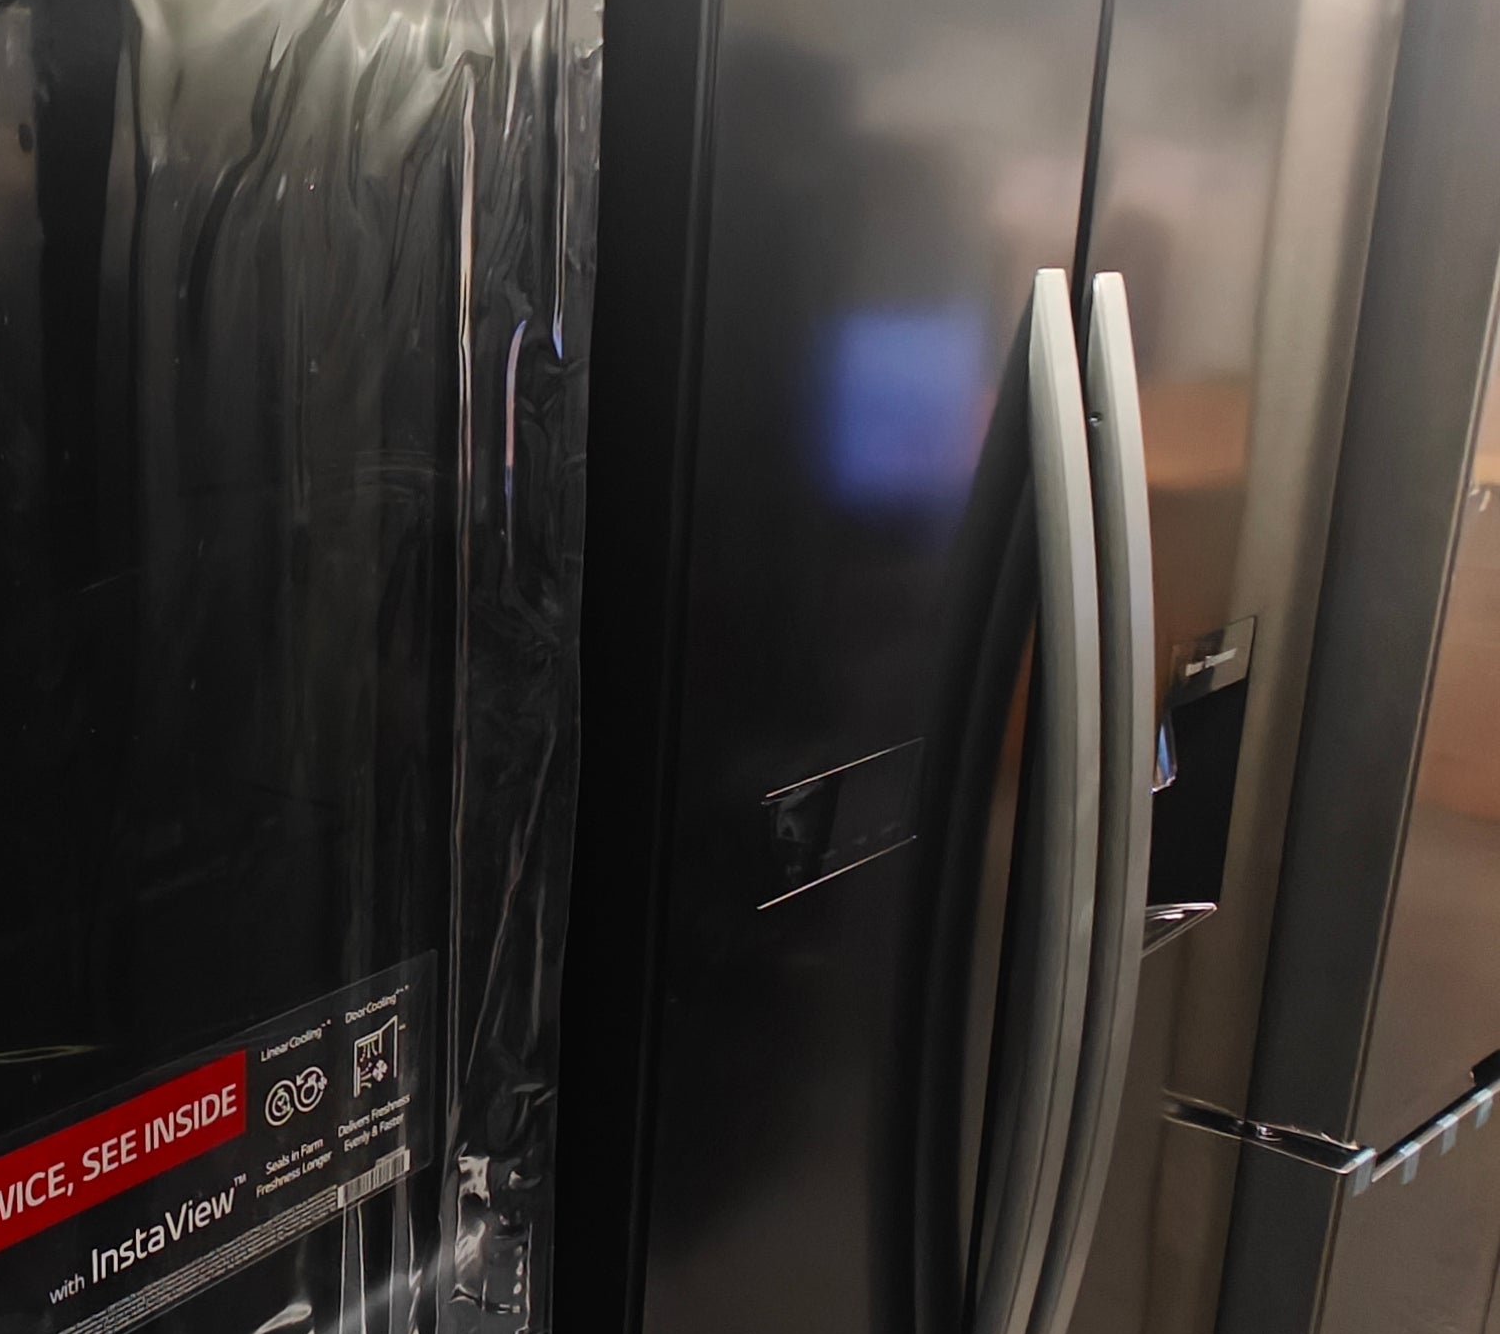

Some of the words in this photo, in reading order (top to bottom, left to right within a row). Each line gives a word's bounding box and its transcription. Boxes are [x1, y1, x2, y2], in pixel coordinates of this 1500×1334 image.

[82, 1128, 138, 1182] SEE
[144, 1082, 238, 1154] INSIDE
[337, 1114, 371, 1139] Delivers
[371, 1093, 411, 1122] Freshness
[256, 1166, 301, 1199] Freshness
[302, 1149, 334, 1175] Longer
[265, 1153, 291, 1176] Seals
[291, 1149, 300, 1162] in
[301, 1137, 325, 1158] Farm
[49, 1272, 86, 1305] with
